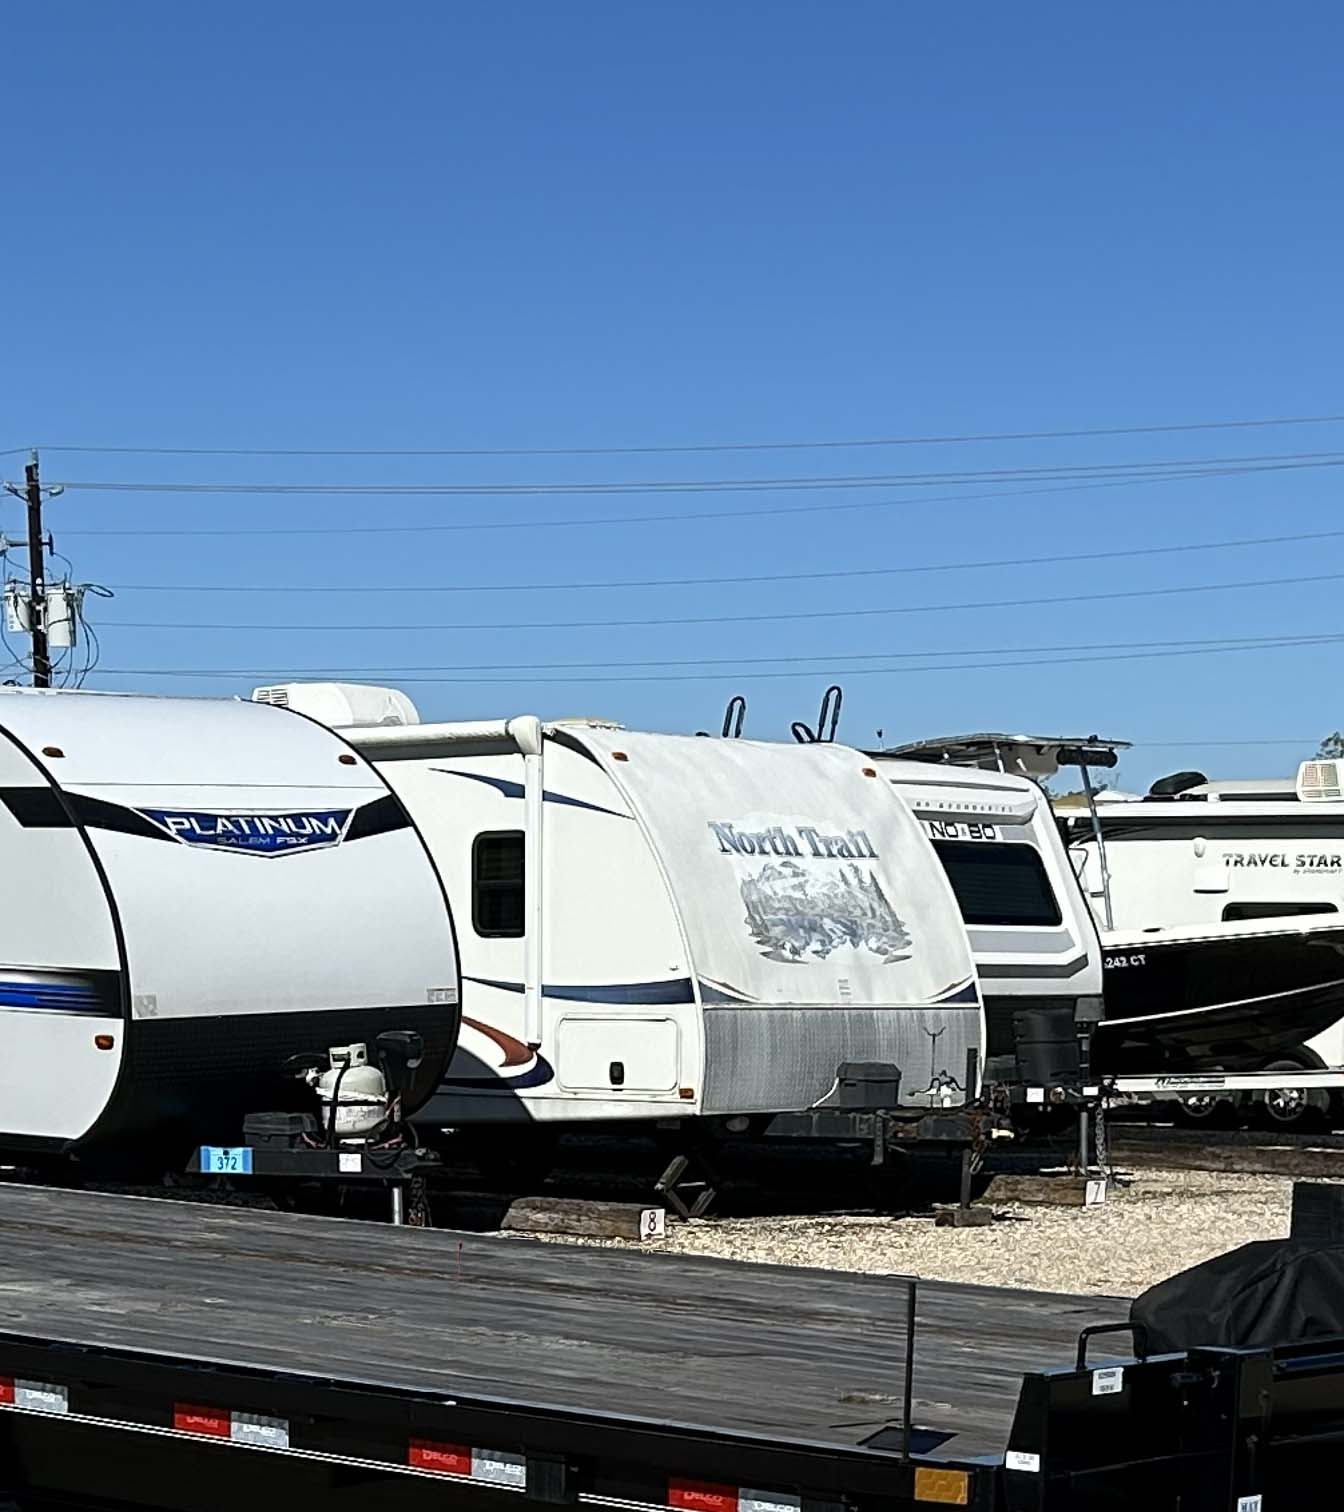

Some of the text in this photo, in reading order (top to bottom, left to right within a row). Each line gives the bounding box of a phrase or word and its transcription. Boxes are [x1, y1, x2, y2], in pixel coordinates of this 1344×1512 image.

[165, 816, 344, 835] PLATINUM
[707, 821, 879, 859] North Trail
[1222, 853, 1342, 867] TRAVEL STAR
[1130, 954, 1146, 967] CT
[217, 1156, 237, 1170] 372
[1093, 1182, 1101, 1201] 7
[648, 1211, 656, 1232] 8
[683, 1491, 723, 1504] DELCO
